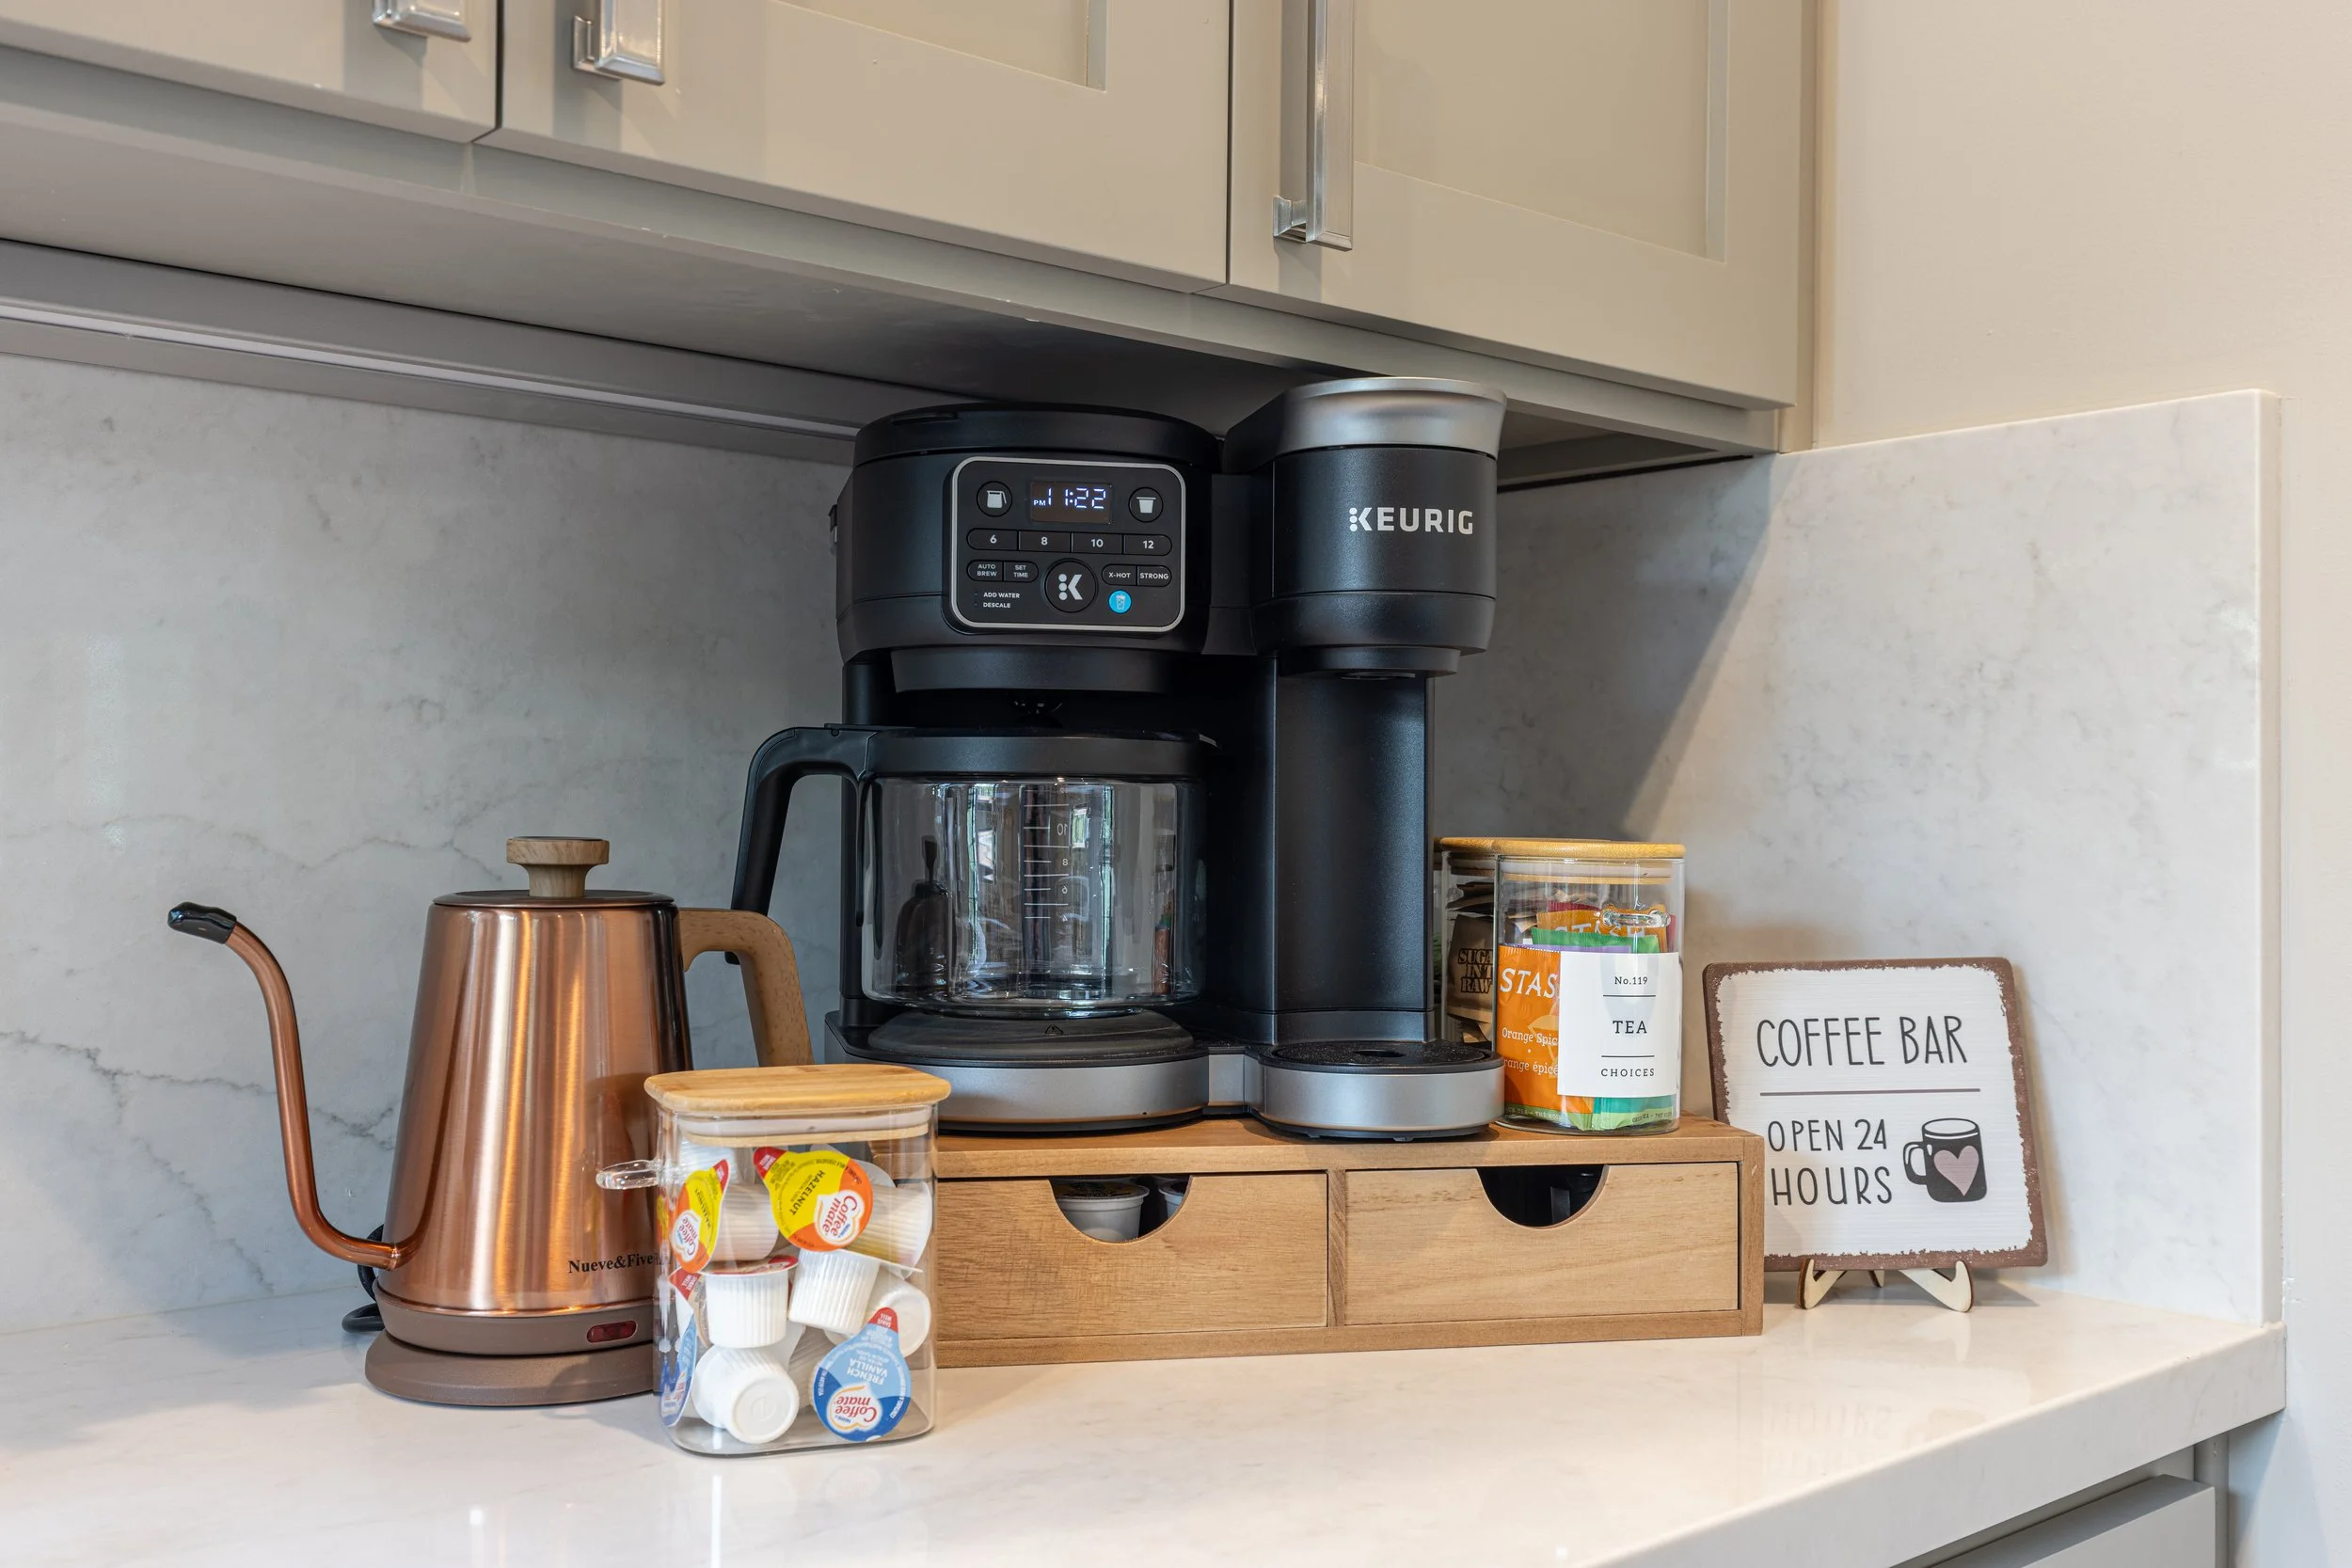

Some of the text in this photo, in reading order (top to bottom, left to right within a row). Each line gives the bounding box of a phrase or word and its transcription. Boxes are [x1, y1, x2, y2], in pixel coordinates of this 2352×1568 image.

[1349, 507, 1473, 535] KEURIG
[990, 534, 997, 544] 6
[1041, 536, 1048, 546] 8
[1090, 539, 1104, 547] 10
[1142, 540, 1154, 549] 12
[1458, 948, 1493, 965] SUGA
[1461, 977, 1493, 994] RAW
[1500, 968, 1559, 999] STAS
[1614, 976, 1648, 985] No.119
[1502, 1027, 1558, 1046] Orange Spic
[1613, 1020, 1647, 1035] TEA
[1756, 1015, 1968, 1067] COFFEE BAR
[1503, 1058, 1530, 1072] range
[1600, 1068, 1655, 1077] CHOICES
[1767, 1118, 1888, 1152] OPEN 24
[790, 1170, 825, 1215] HAZELNUT
[1771, 1166, 1893, 1206] HOURS
[822, 1197, 841, 1233] mate
[831, 1196, 857, 1236] Coffee
[568, 1253, 654, 1274] Nueve&Five
[848, 1367, 884, 1386] FRENCH
[850, 1358, 887, 1377] VANILLA
[836, 1396, 870, 1406] mate
[835, 1405, 877, 1423] Coffee
